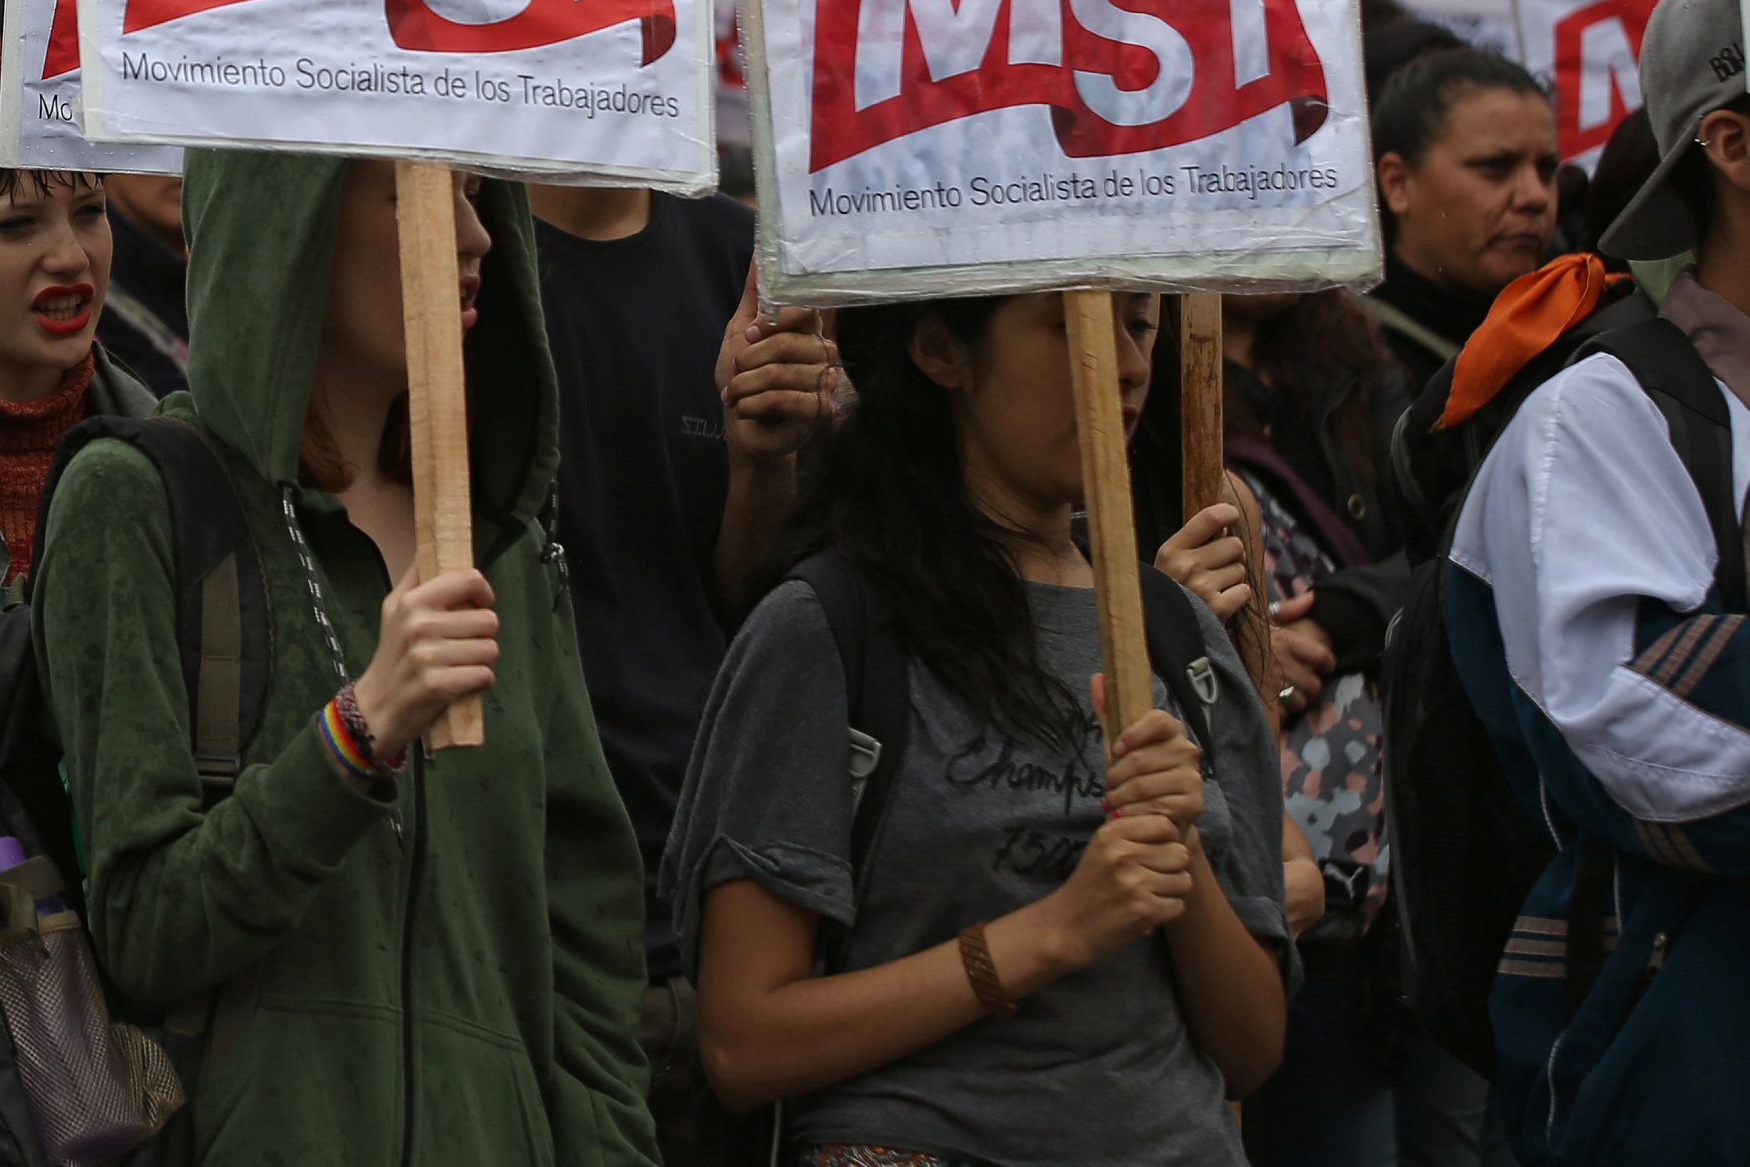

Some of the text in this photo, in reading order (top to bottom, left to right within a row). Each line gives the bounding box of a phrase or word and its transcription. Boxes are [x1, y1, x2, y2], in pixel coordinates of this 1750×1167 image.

[122, 51, 680, 120] Movimiento Socialista de los Trabajadores
[808, 162, 1339, 217] Movimiento Socialista de los Trabajadores
